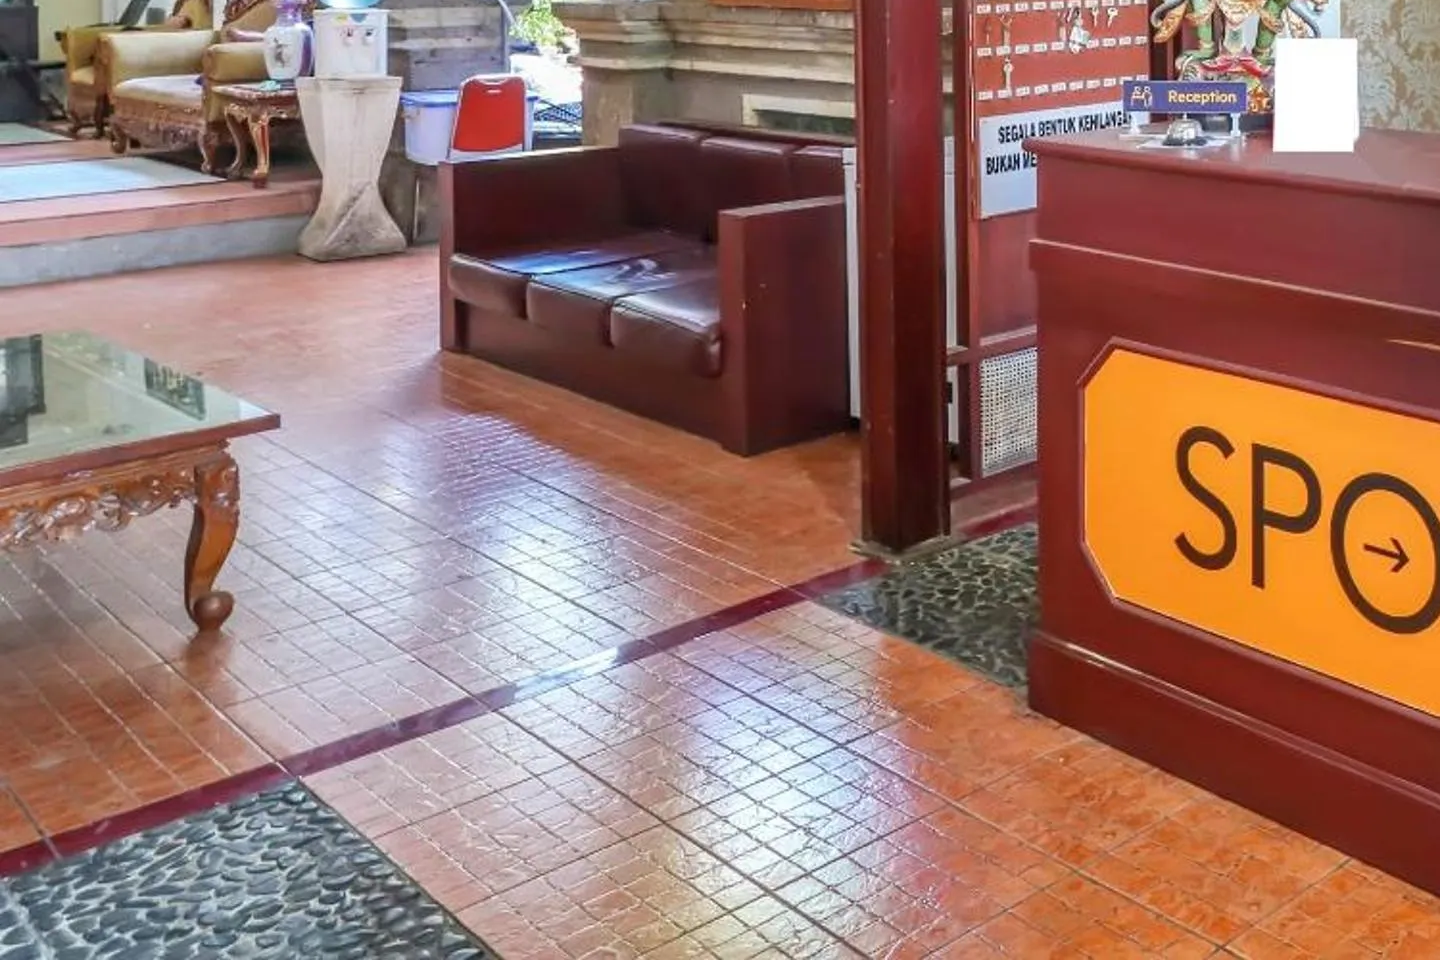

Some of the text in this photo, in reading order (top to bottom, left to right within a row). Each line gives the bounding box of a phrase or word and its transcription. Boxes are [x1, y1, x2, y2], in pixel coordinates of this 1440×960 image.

[1168, 89, 1237, 106] Reception
[998, 124, 1036, 144] SEGALA
[1038, 116, 1076, 137] BENTUK
[986, 153, 1021, 175] BUKAN
